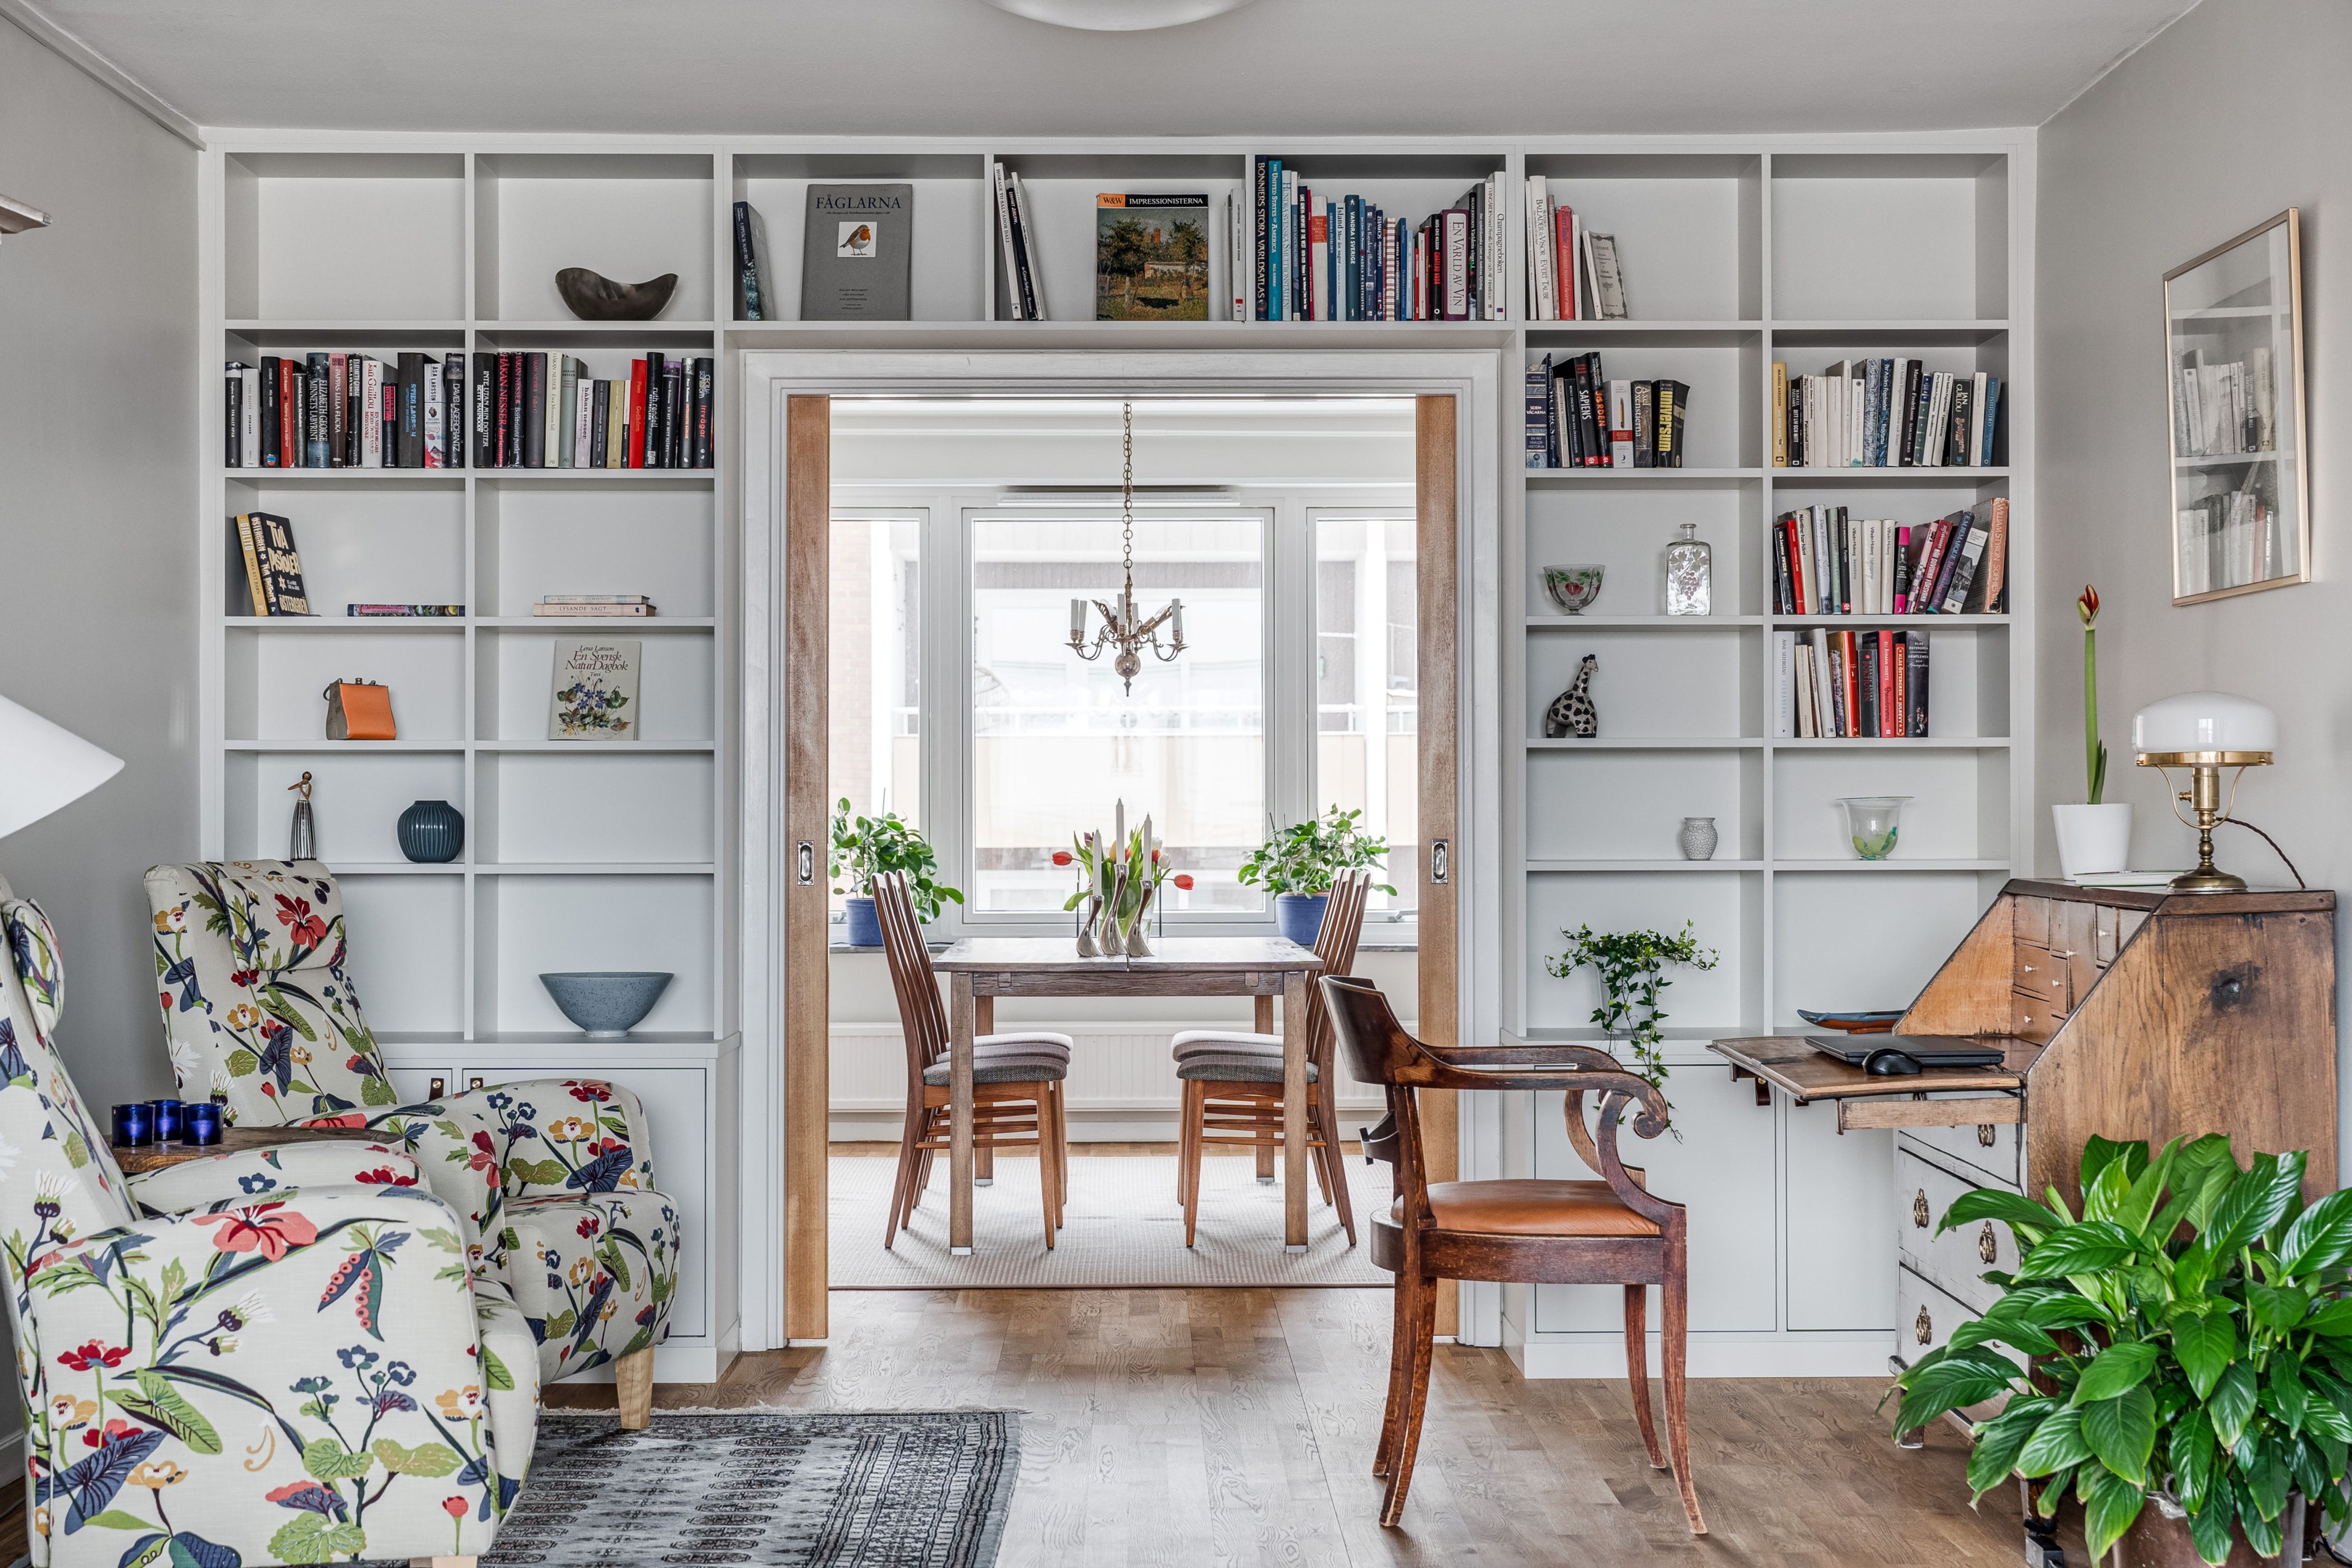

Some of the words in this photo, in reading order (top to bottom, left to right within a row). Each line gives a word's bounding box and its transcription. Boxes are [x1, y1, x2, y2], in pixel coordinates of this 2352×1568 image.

[815, 193, 902, 209] FÅGLARNA
[1453, 221, 1464, 236] EN
[1453, 237, 1464, 272] VÄRLD
[1495, 213, 1505, 274] Champagneboken
[1283, 243, 1291, 310] SMULTRONSTÄLLEN!
[1453, 274, 1462, 286] AV
[1540, 259, 1548, 279] EVERT
[1453, 288, 1464, 306] VIN
[367, 363, 377, 377] Jan
[499, 354, 510, 386] HÅKAN
[309, 380, 318, 409] MINNETS
[319, 380, 327, 415] ELIZABETH
[367, 378, 377, 409] Guillou
[499, 389, 507, 425] NESSER
[1579, 390, 1592, 420] SAPIENS
[1642, 387, 1651, 406] Axel
[309, 410, 318, 441] LABYRINT
[319, 415, 327, 441] GEORGE
[698, 404, 708, 438] Irrvägar
[1659, 391, 1673, 452] universum
[1955, 417, 1965, 453] Brobyggarna
[1996, 503, 2005, 533] WILLIAM
[266, 520, 289, 550] TVÅ
[1993, 533, 2003, 561] STYRON
[266, 547, 301, 576] PISTOLER
[1932, 548, 1941, 558] NÄR
[1927, 558, 1938, 579] DUVORNA
[1992, 564, 2001, 592] SOPHIES
[277, 594, 309, 614] ÖSTERGREN
[1920, 579, 1932, 603] FÖRSVANN
[564, 660, 629, 674] NaturDagbok
[572, 650, 588, 661] En
[589, 650, 622, 661] Svensk
